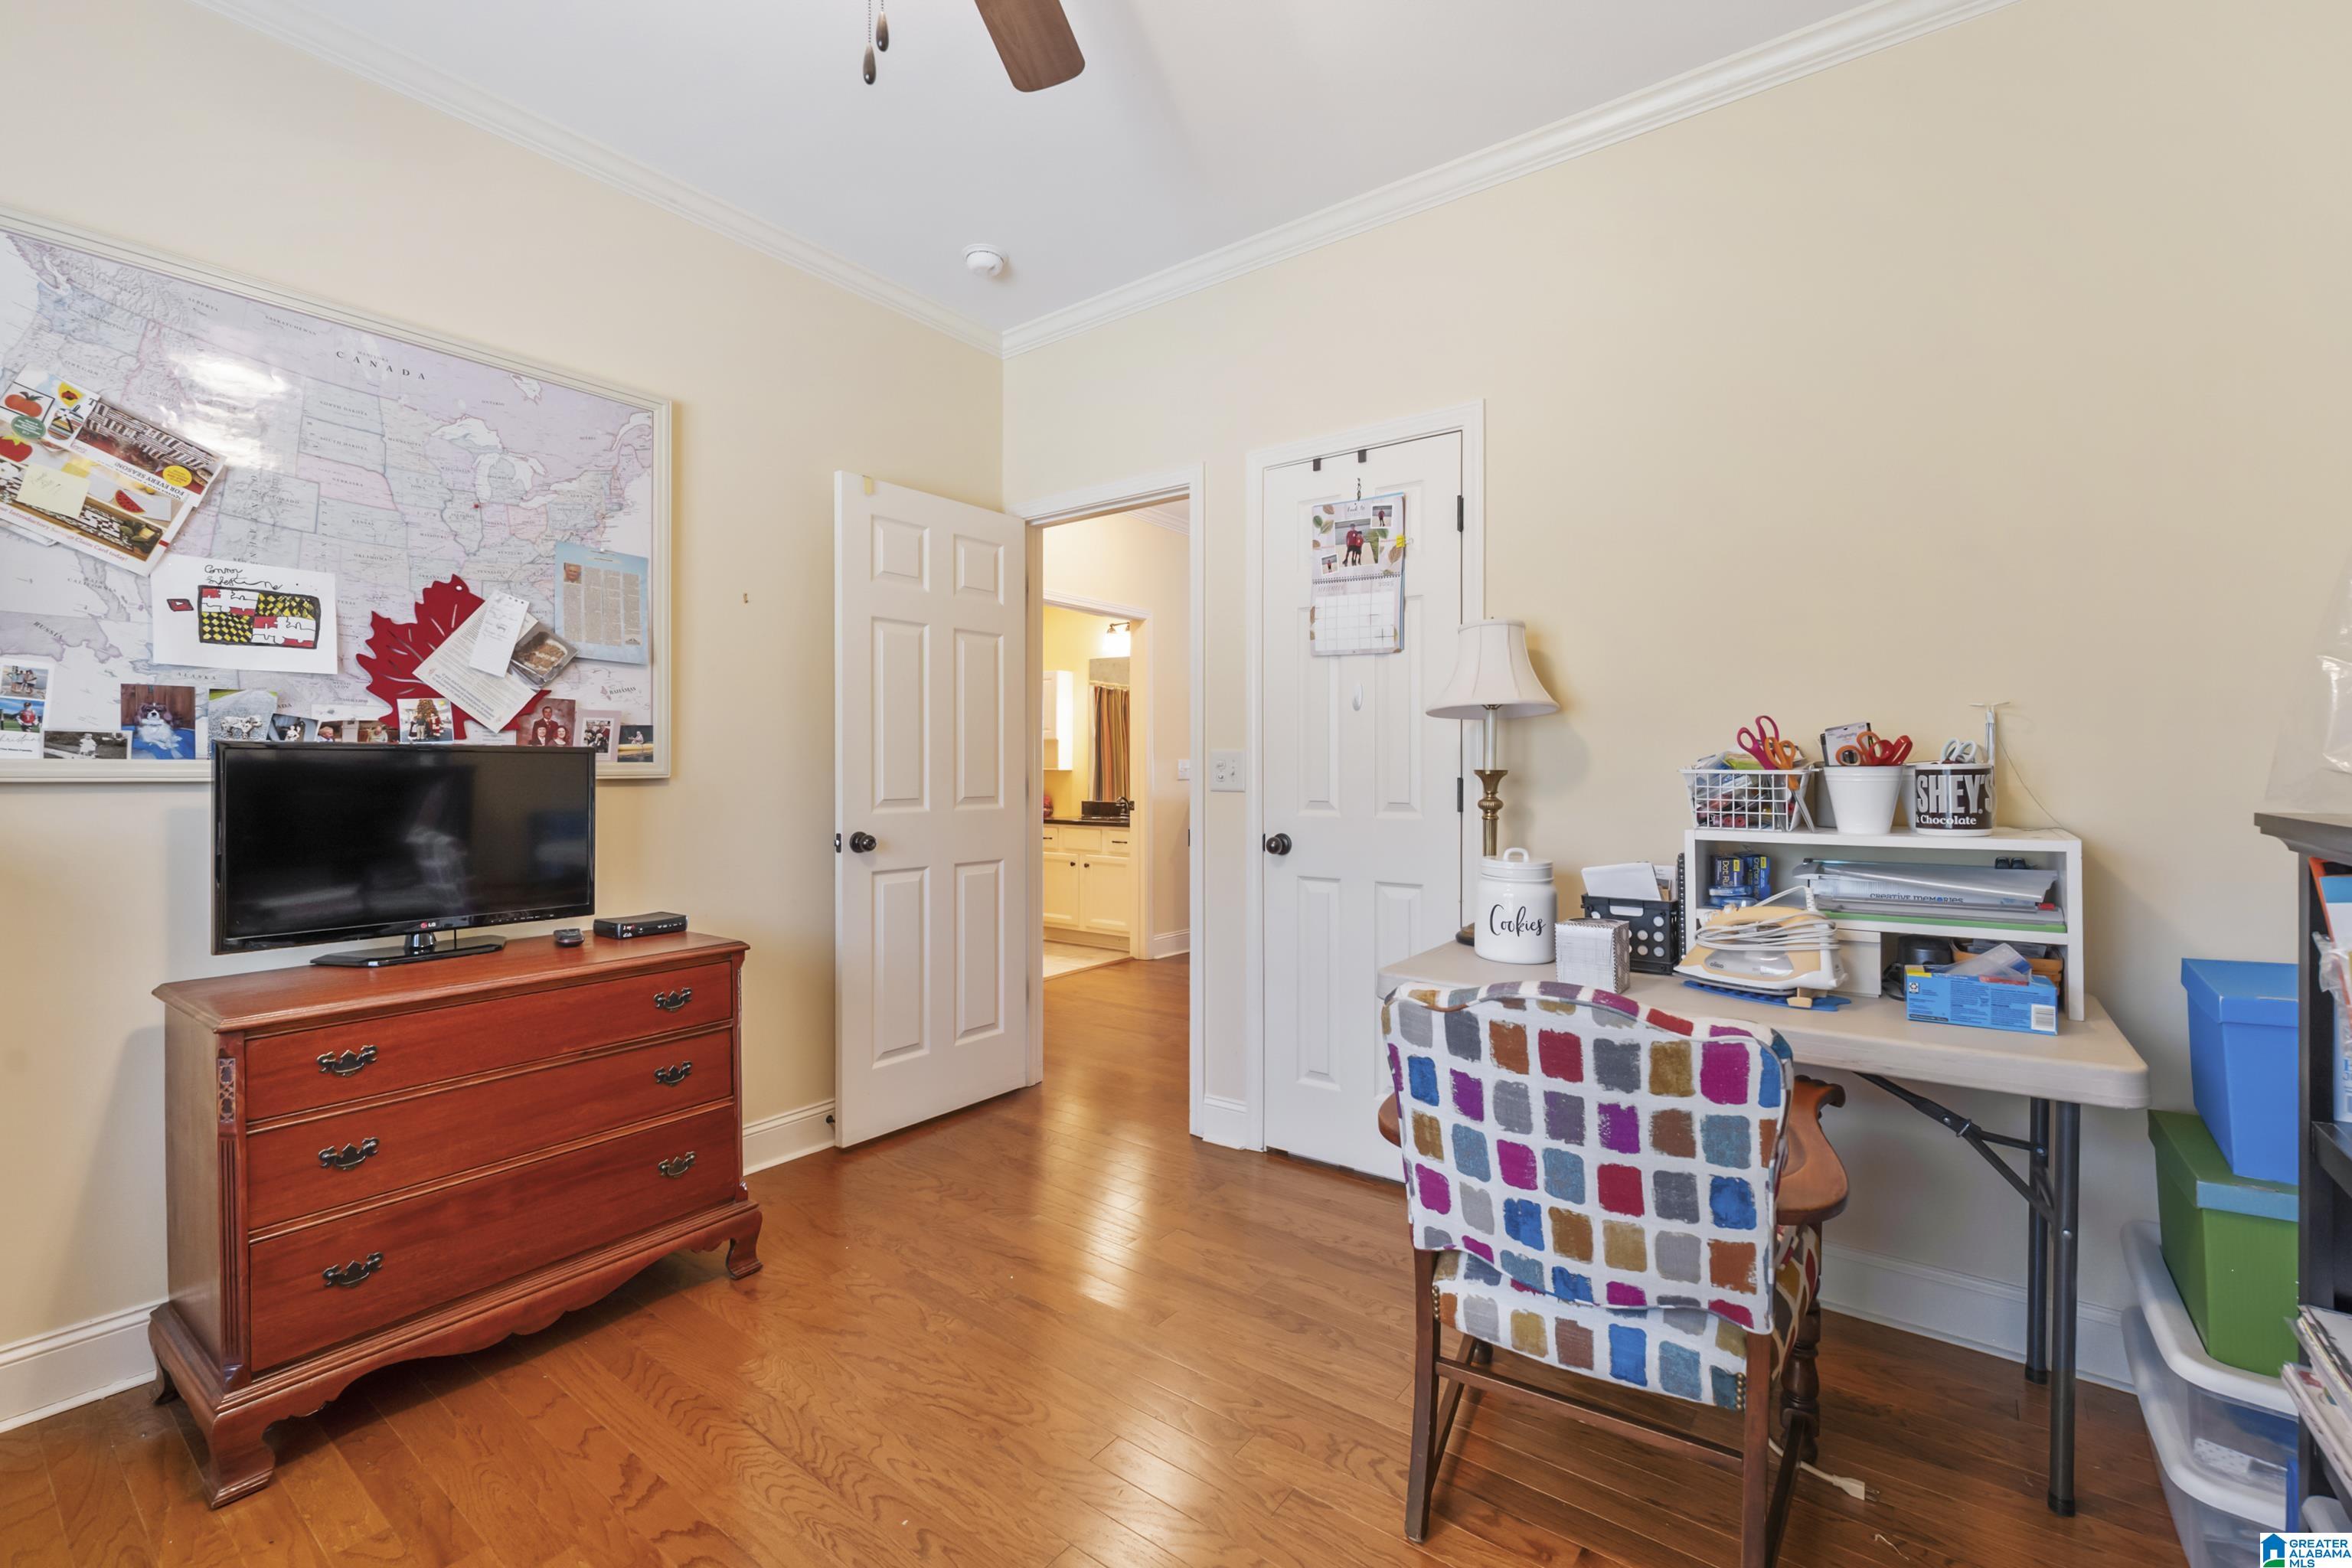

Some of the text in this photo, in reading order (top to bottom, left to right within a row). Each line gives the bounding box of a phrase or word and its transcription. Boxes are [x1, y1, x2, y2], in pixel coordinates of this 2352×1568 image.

[336, 351, 426, 381] CANADA
[146, 476, 170, 492] EVERY
[170, 487, 185, 497] FOR
[33, 621, 63, 640] RUSSIA
[177, 671, 217, 681] ALASKA
[1916, 774, 1993, 814] SHEY'S
[1920, 815, 1977, 825] Chocolate
[1489, 903, 1546, 937] Cookies
